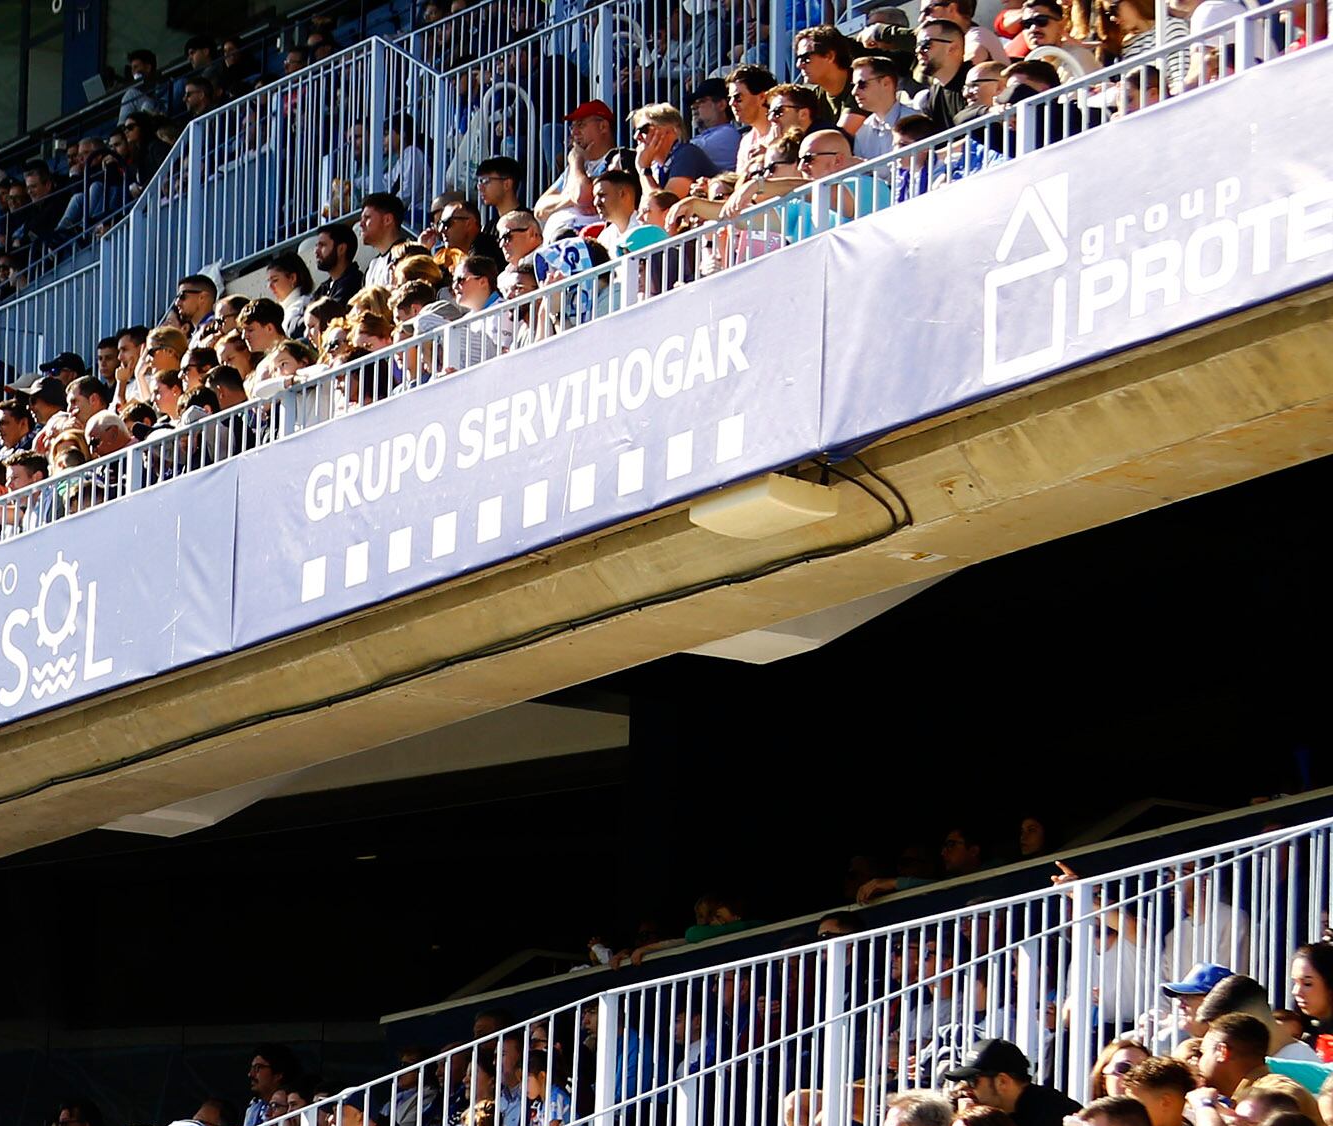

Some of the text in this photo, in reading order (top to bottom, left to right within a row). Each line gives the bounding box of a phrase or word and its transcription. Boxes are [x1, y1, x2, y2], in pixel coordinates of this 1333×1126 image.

[1077, 182, 1333, 336] PROTE
[1080, 176, 1242, 263] group
[303, 313, 751, 522] GRUPO SERVIHOGAR
